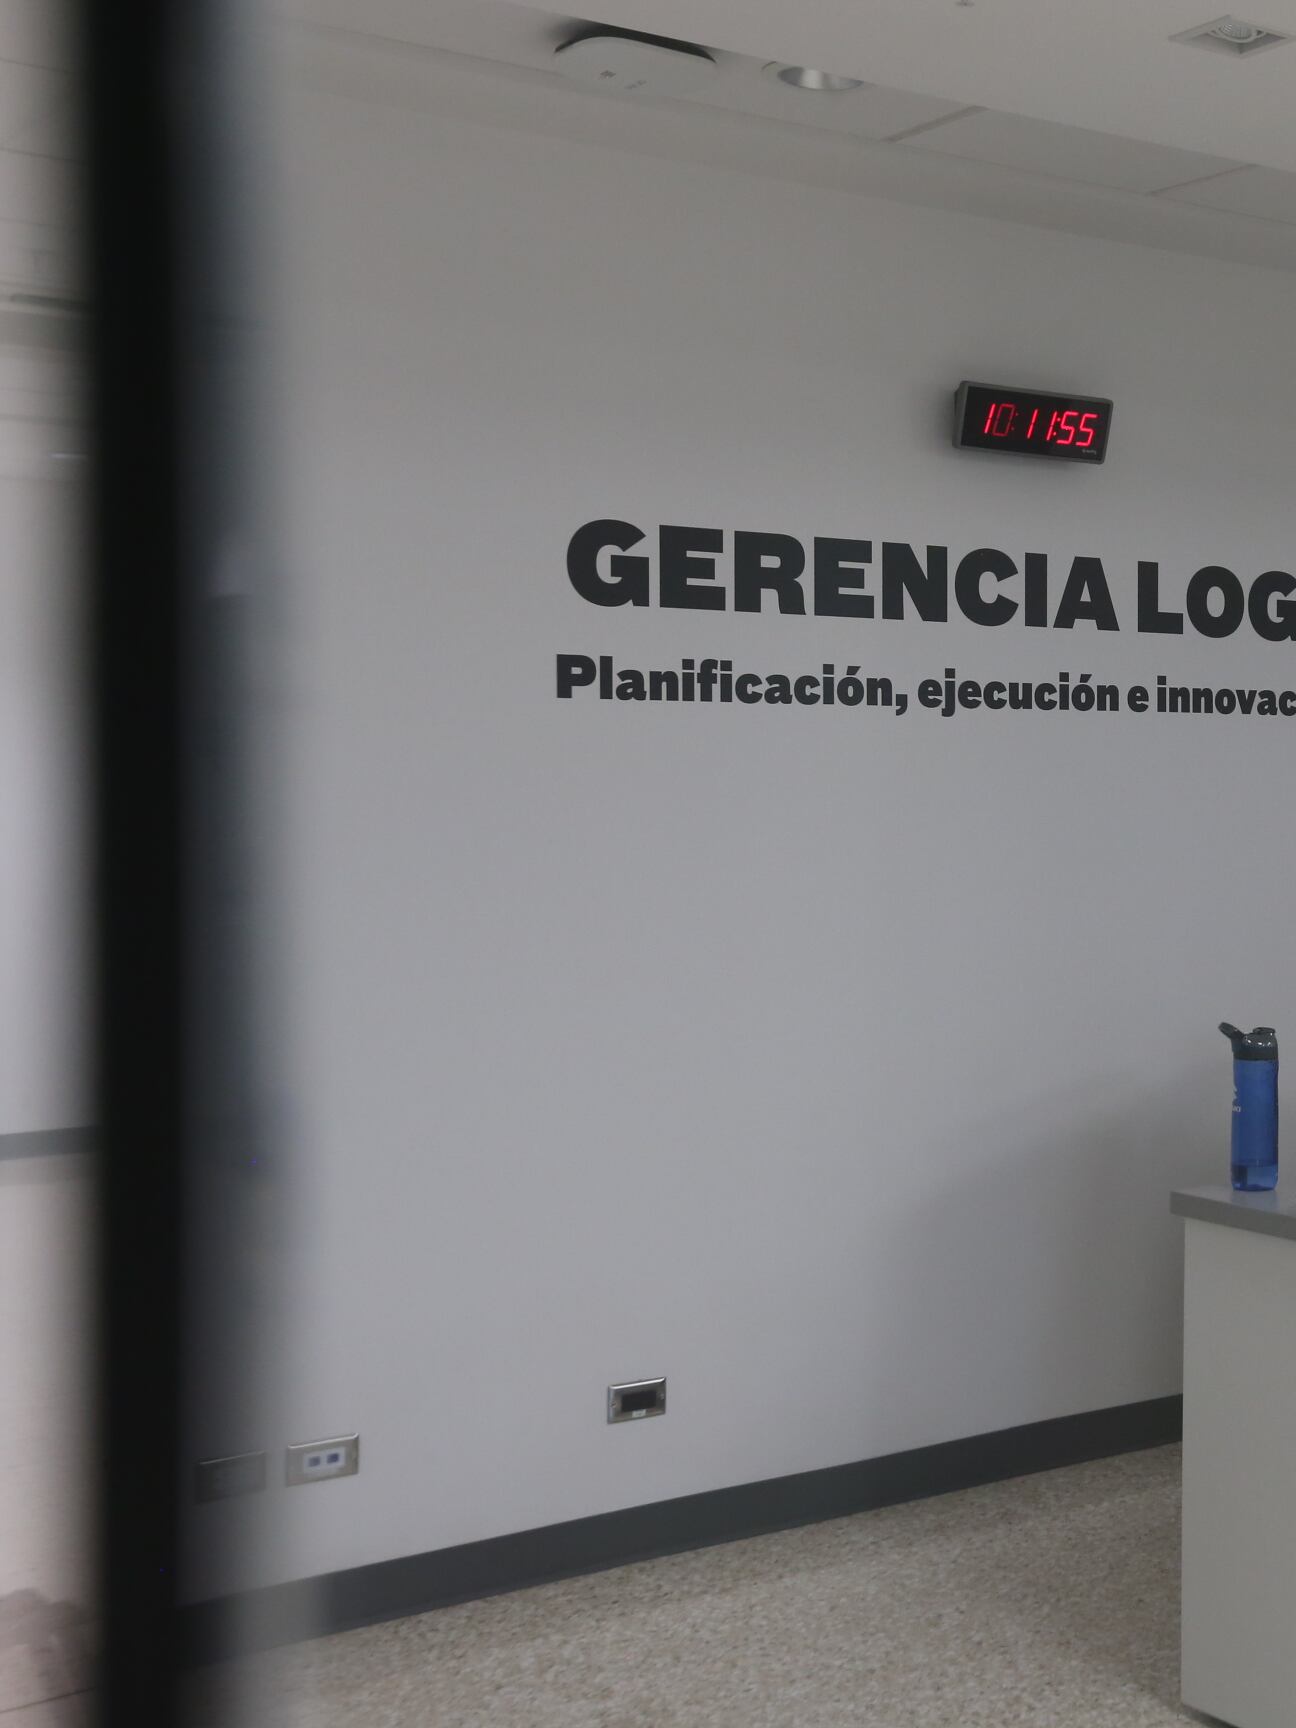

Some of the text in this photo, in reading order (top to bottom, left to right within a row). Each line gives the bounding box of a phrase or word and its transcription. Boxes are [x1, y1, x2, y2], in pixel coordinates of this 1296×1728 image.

[566, 518, 1121, 635] GERENCIA
[556, 653, 908, 717] Planificación,
[917, 671, 1120, 719] ejecución
[1126, 685, 1150, 713] e
